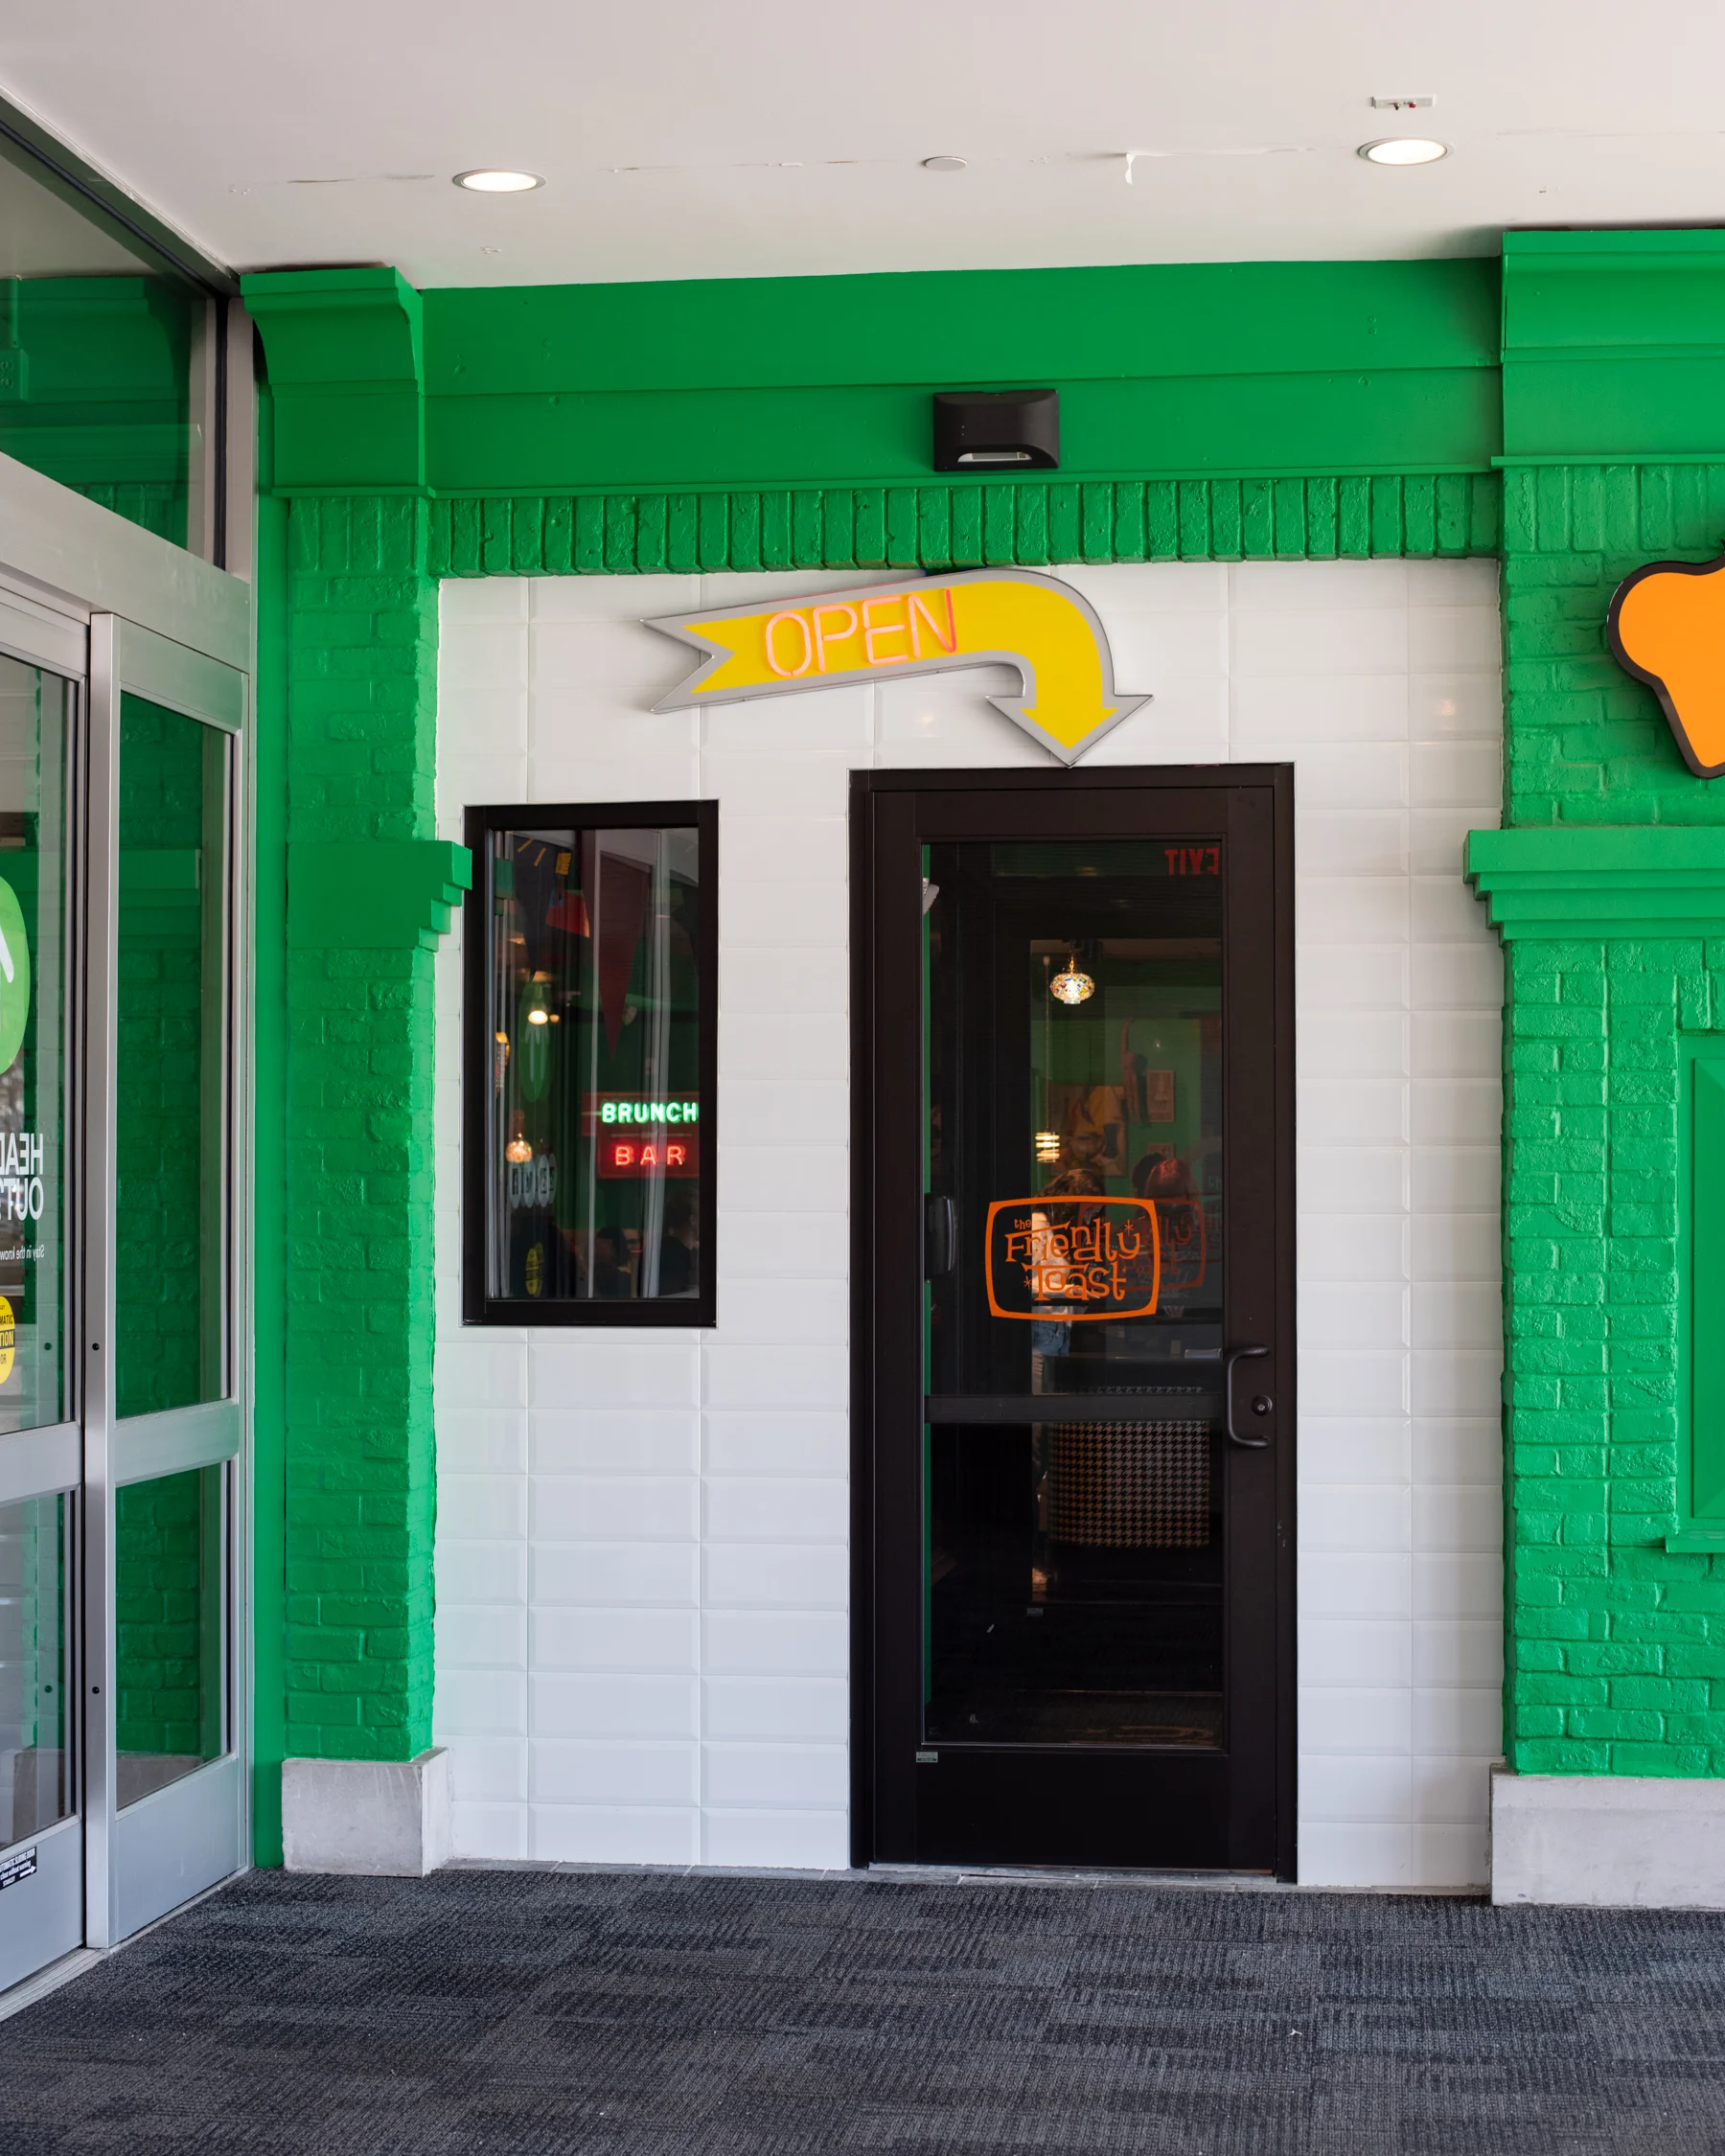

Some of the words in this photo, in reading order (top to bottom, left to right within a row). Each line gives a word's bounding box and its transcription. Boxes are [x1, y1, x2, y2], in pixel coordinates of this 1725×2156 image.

[766, 588, 957, 677] OPEN
[601, 1101, 700, 1124] BRUNCH
[615, 1144, 686, 1166] BAR
[1004, 1217, 1140, 1263] Friendly
[1014, 1218, 1032, 1230] the
[1022, 1261, 1127, 1302] Toast
